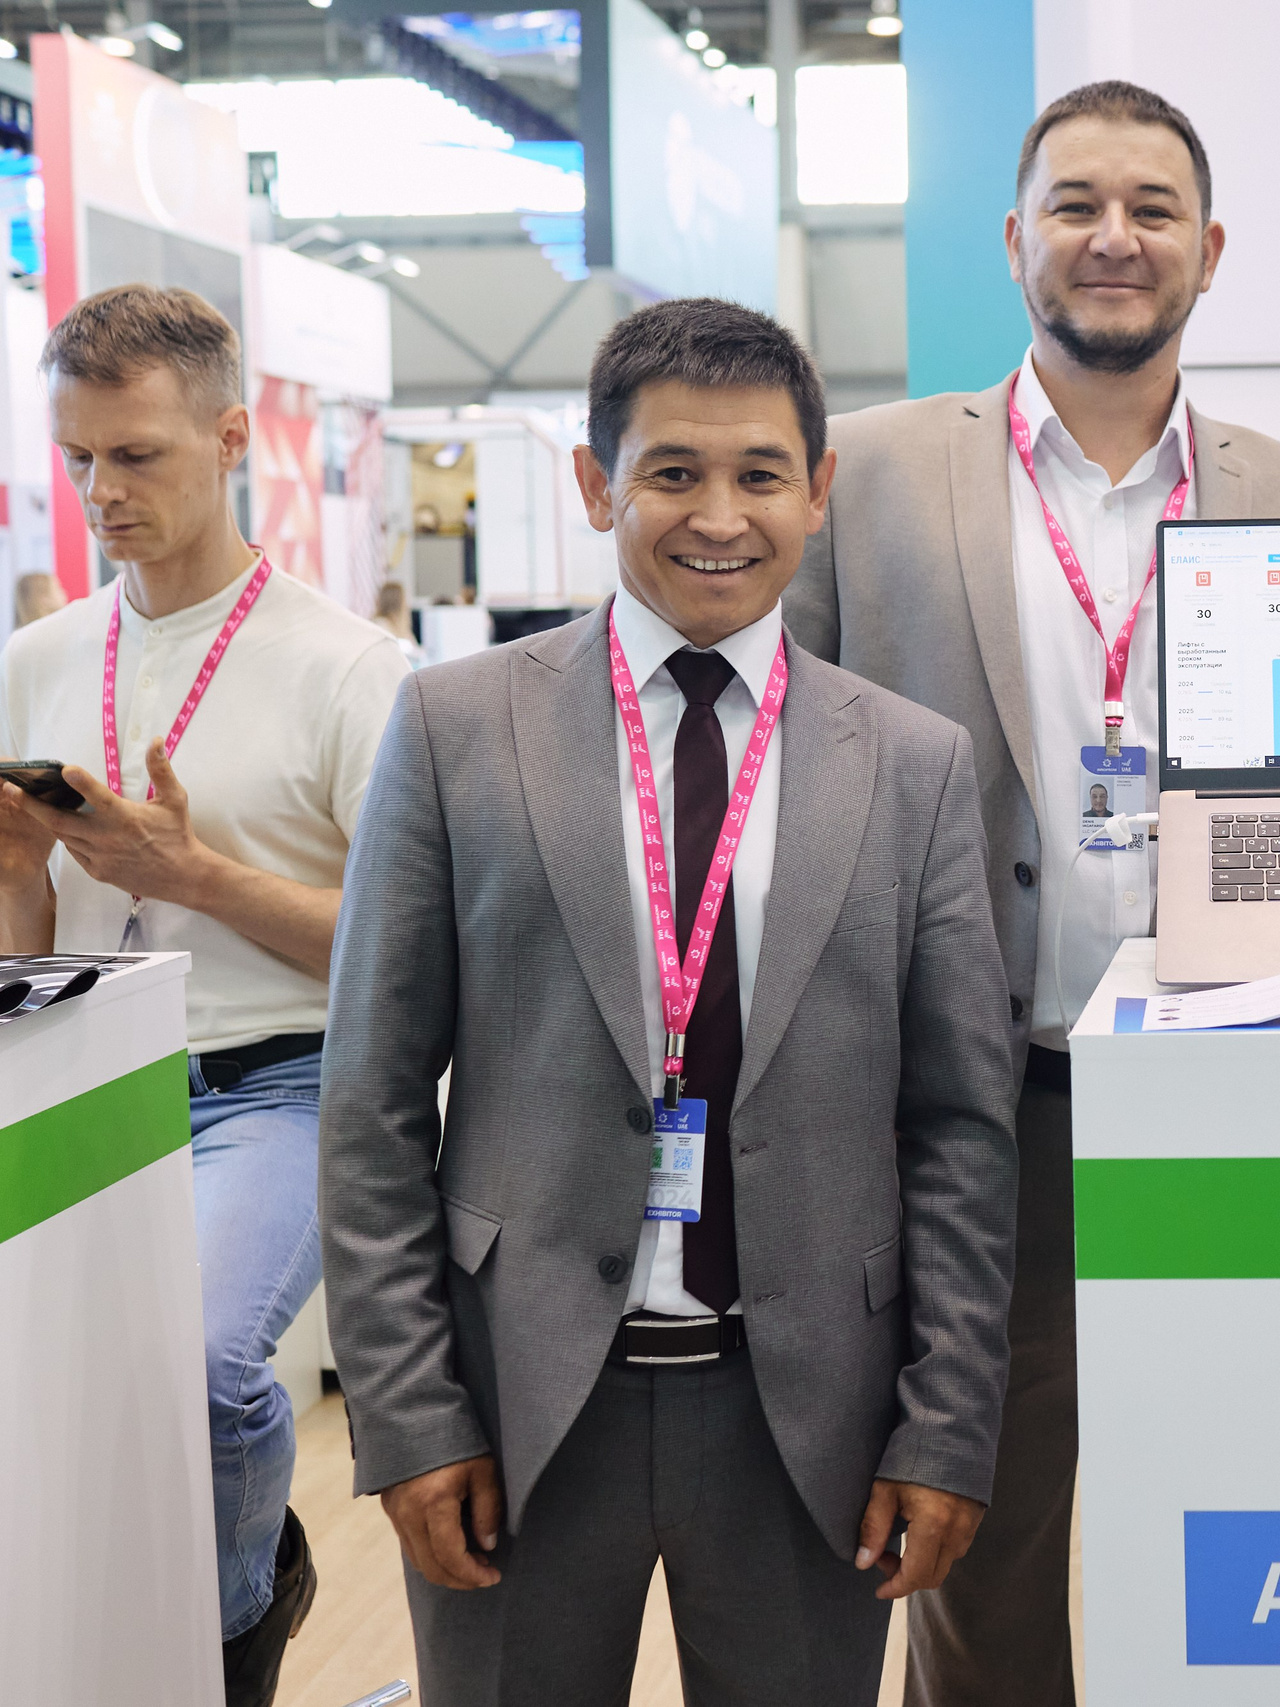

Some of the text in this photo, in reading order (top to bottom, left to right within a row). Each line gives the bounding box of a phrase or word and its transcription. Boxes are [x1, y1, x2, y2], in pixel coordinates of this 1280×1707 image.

[1171, 555, 1201, 564] ЕЛАИС
[1197, 609, 1212, 619] 30
[754, 754, 762, 765] UAE
[742, 795, 750, 805] UAE
[730, 837, 738, 848] UAE
[717, 882, 725, 893] UAE
[704, 929, 712, 941] UAE
[650, 1188, 695, 1210] 024
[647, 1209, 682, 1218] EXHIBITOR
